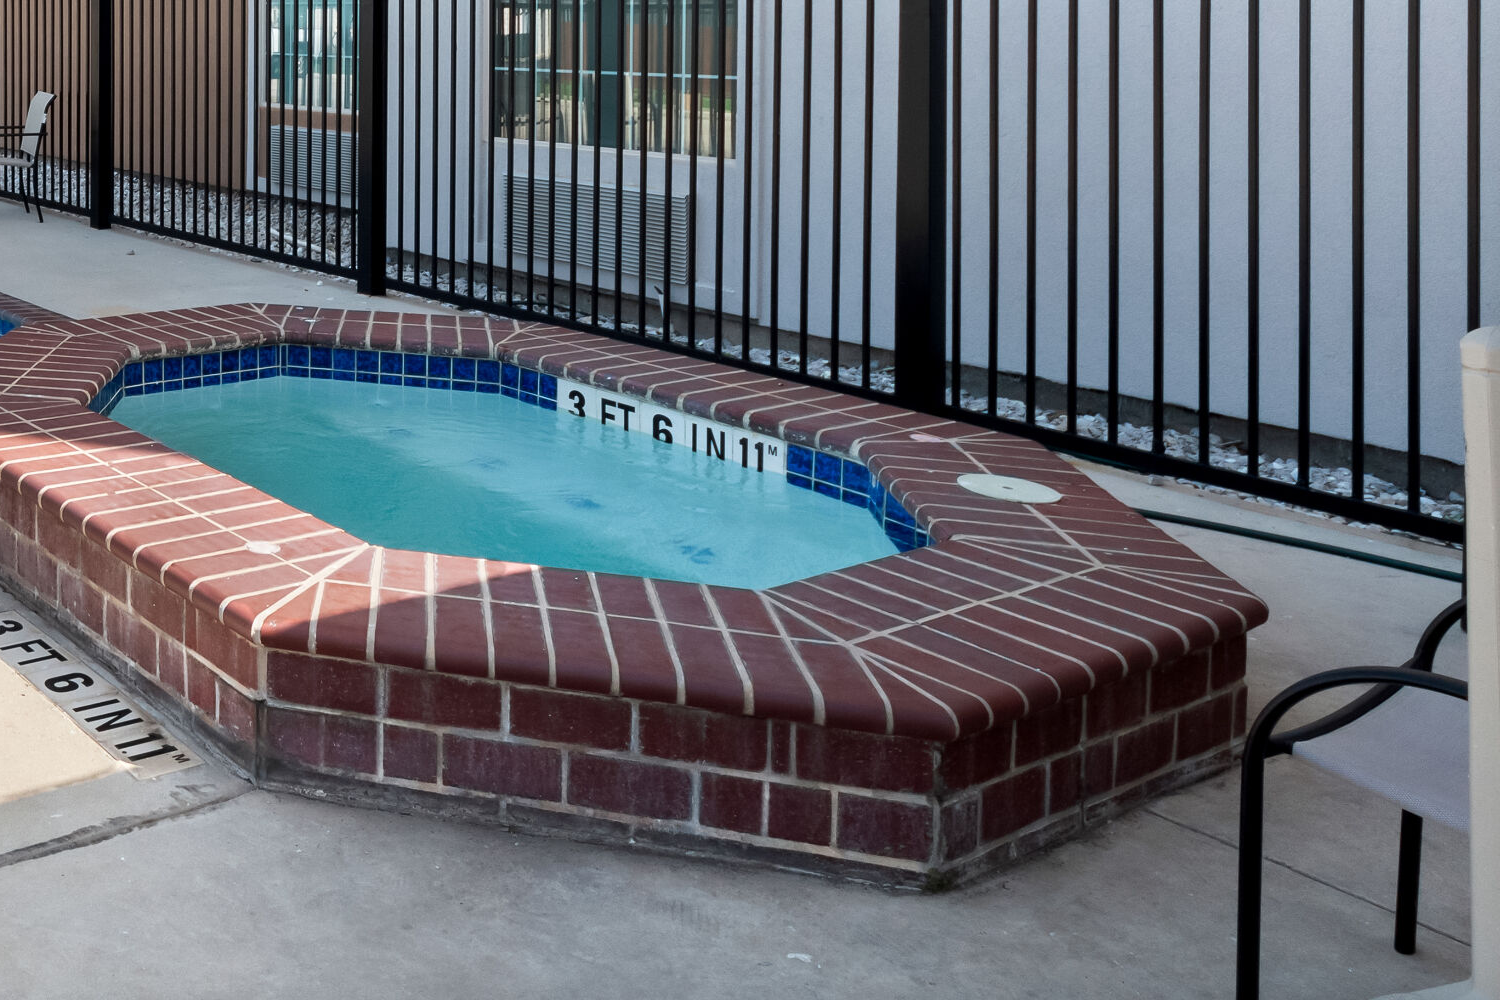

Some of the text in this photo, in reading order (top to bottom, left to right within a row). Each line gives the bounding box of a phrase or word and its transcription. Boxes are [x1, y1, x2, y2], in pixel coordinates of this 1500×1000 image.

[568, 389, 586, 417] 3
[601, 397, 636, 432] FT
[652, 413, 673, 444] 6
[692, 422, 726, 461] IN
[0, 638, 68, 666] FT
[44, 672, 94, 693] 6
[72, 698, 144, 732] IN
